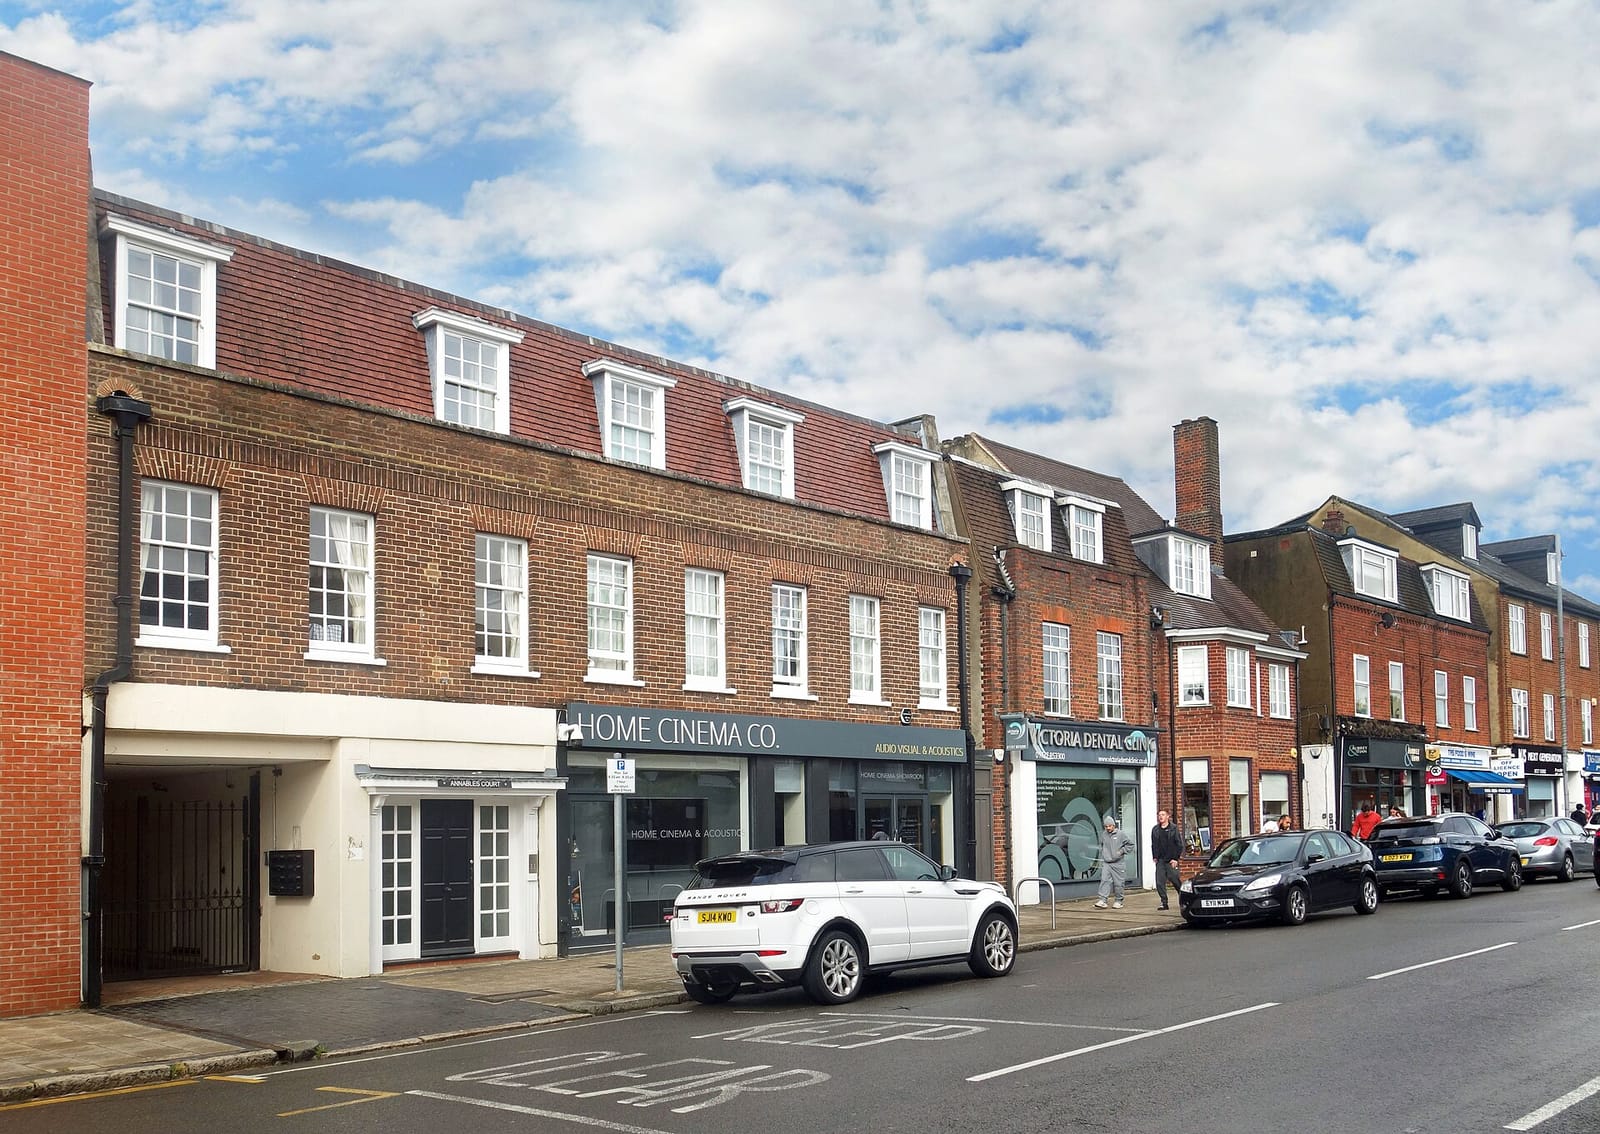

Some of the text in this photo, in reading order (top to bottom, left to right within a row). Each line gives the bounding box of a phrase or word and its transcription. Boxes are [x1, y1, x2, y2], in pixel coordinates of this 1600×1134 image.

[578, 712, 780, 749] HOME CINEMA CO.
[1083, 732, 1124, 750] DENTAL
[875, 743, 964, 757] AUDIO VISUAL & ACOUSTICS
[876, 772, 896, 780] CINEMA
[631, 829, 657, 839] HOME
[660, 829, 693, 839] CINEMA
[694, 829, 701, 838] &
[702, 913, 716, 922] SJ14
[690, 1018, 991, 1049] KEEP
[444, 1050, 832, 1114] CLEAR
